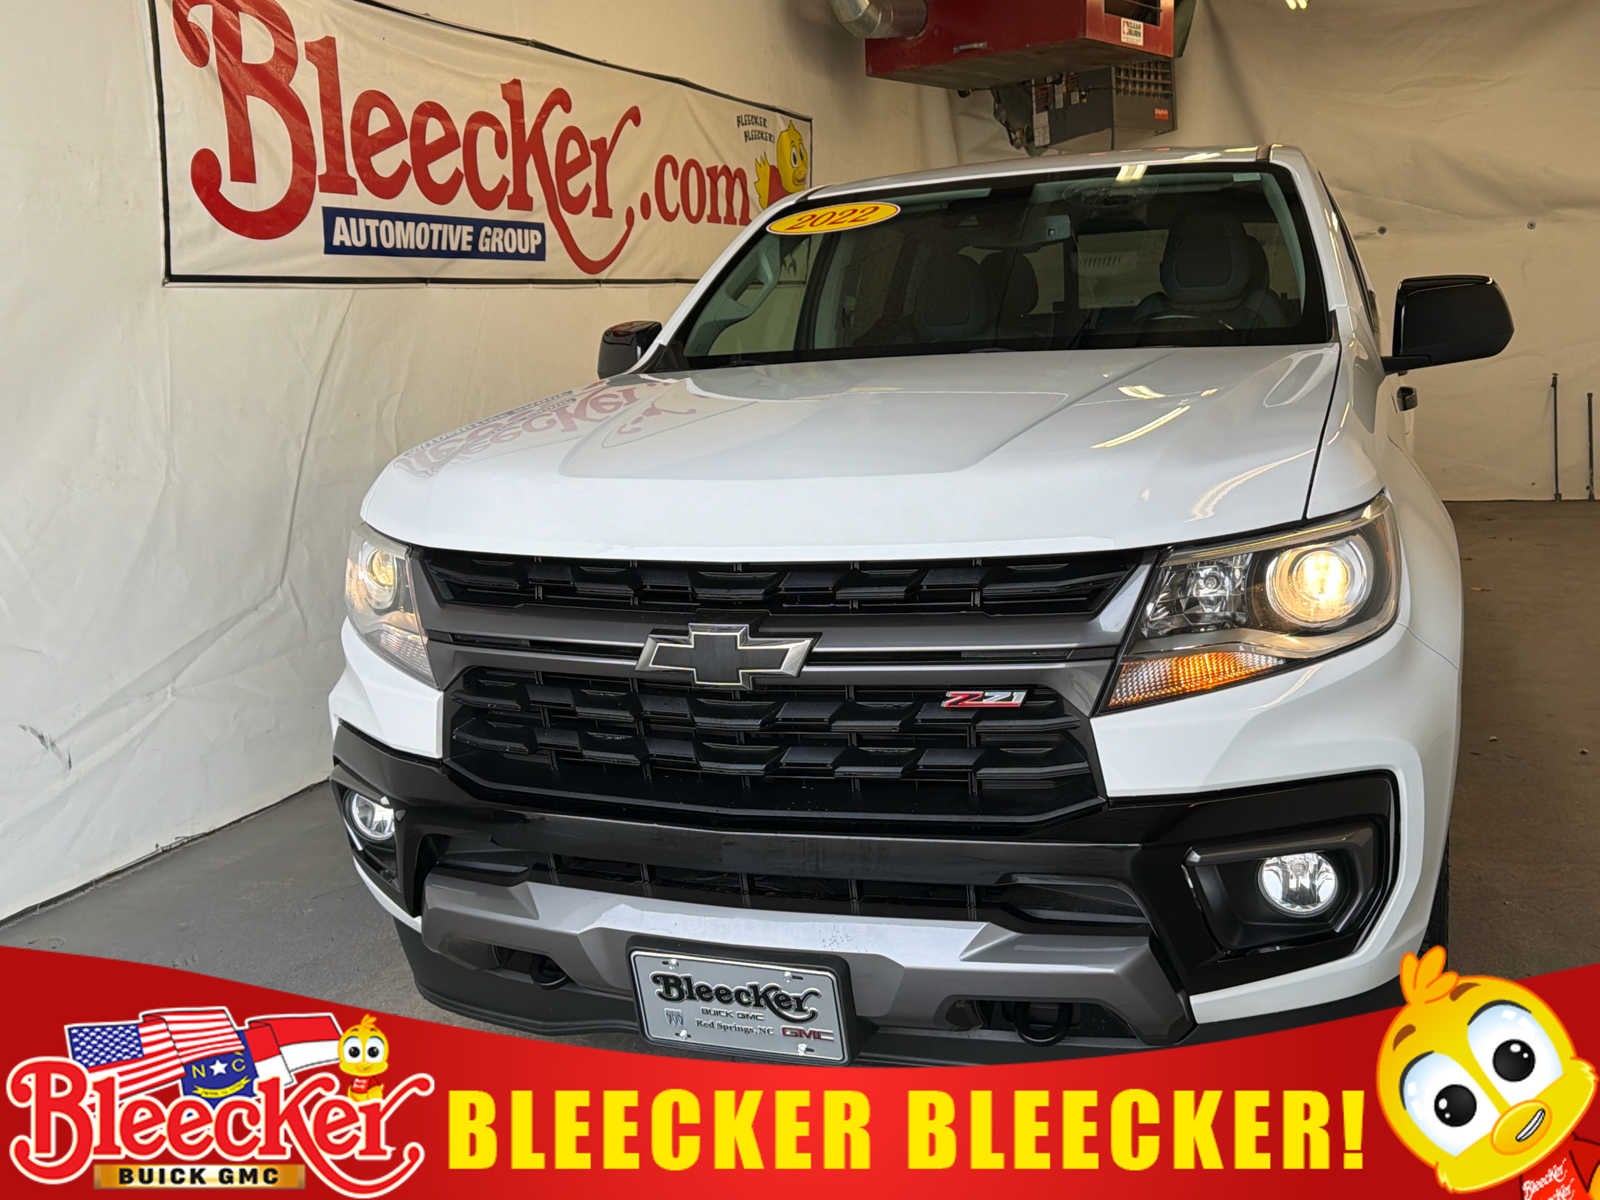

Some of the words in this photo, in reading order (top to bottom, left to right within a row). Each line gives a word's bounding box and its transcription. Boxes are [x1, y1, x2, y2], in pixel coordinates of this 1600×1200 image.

[786, 205, 880, 230] 2022
[332, 216, 474, 251] AUTOMOTIVE
[478, 226, 542, 254] GROUP
[650, 971, 821, 1023] Bleecker
[696, 1019, 715, 1029] Red
[701, 1008, 733, 1018] BUICK
[737, 1012, 764, 1021] GMC
[782, 1026, 834, 1041] GMC
